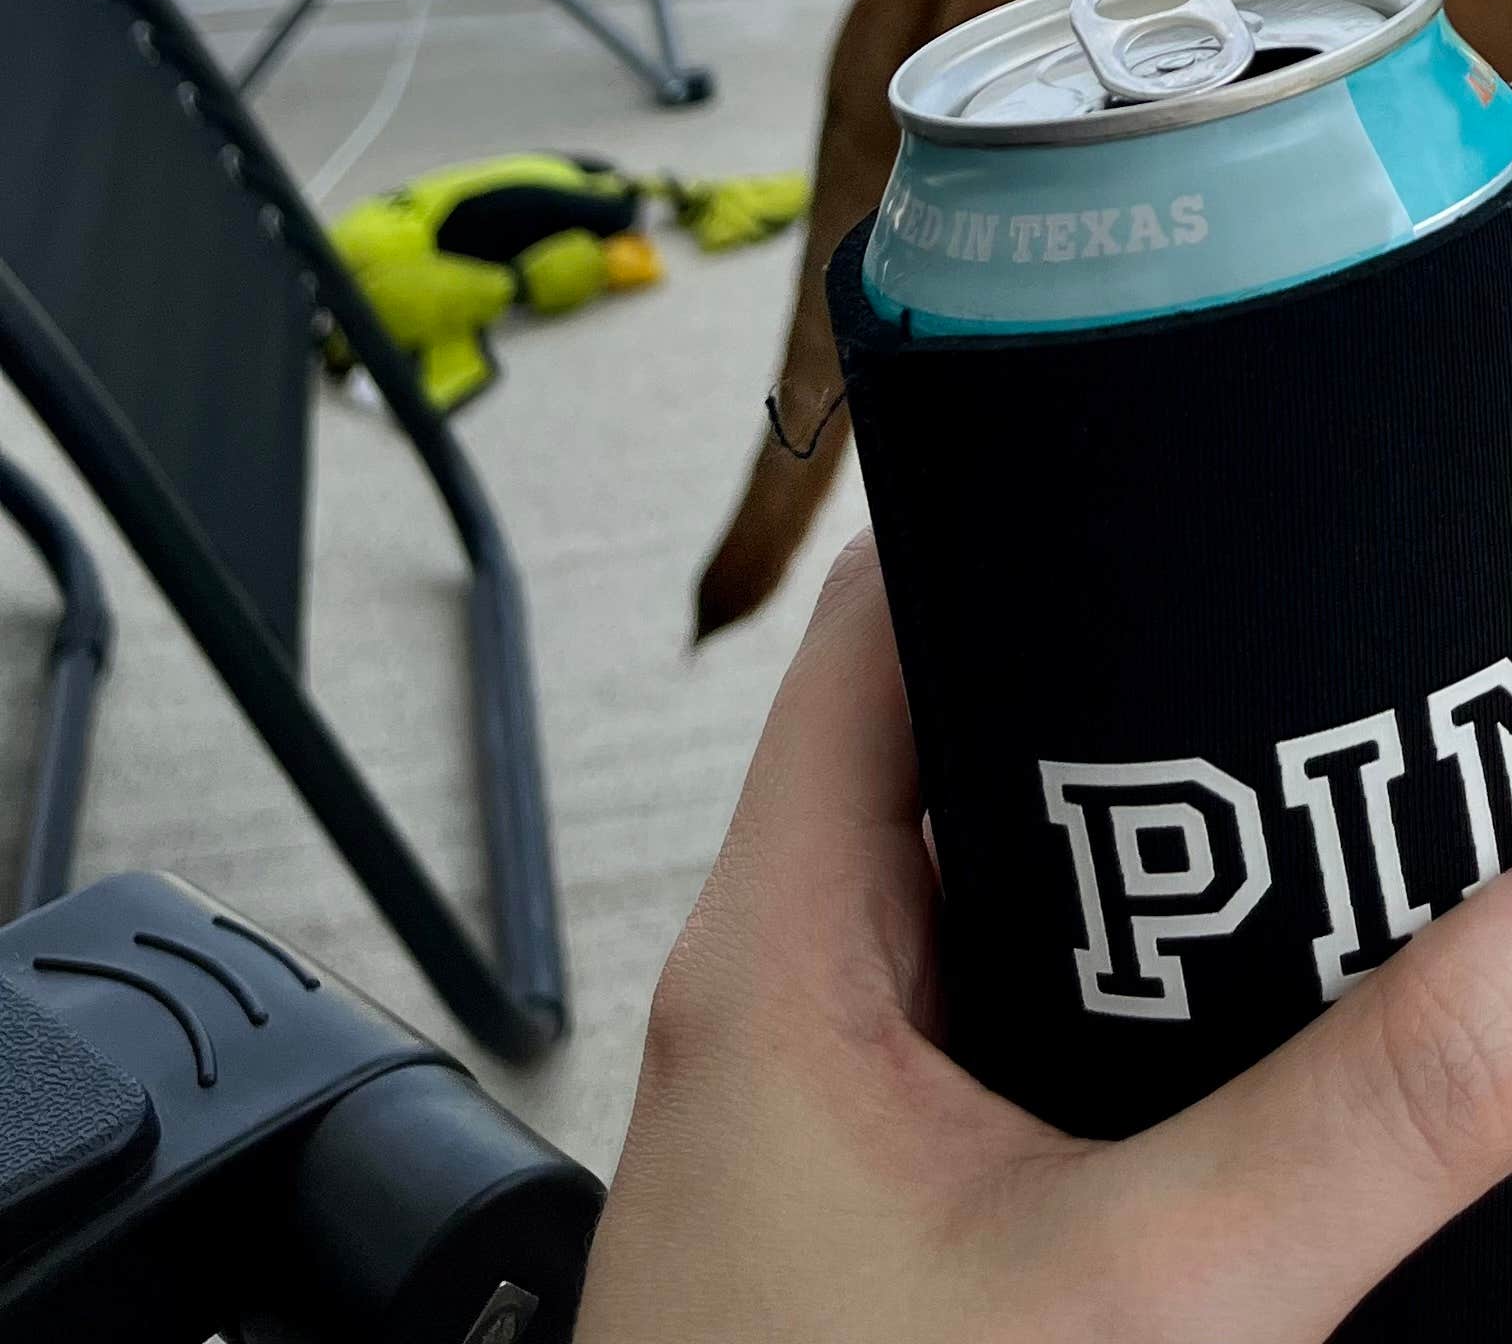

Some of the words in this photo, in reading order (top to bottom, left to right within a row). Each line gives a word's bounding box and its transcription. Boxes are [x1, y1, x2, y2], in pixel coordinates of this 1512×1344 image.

[894, 195, 944, 252] ED
[946, 210, 1000, 262] IN
[1009, 193, 1209, 263] TEXAS
